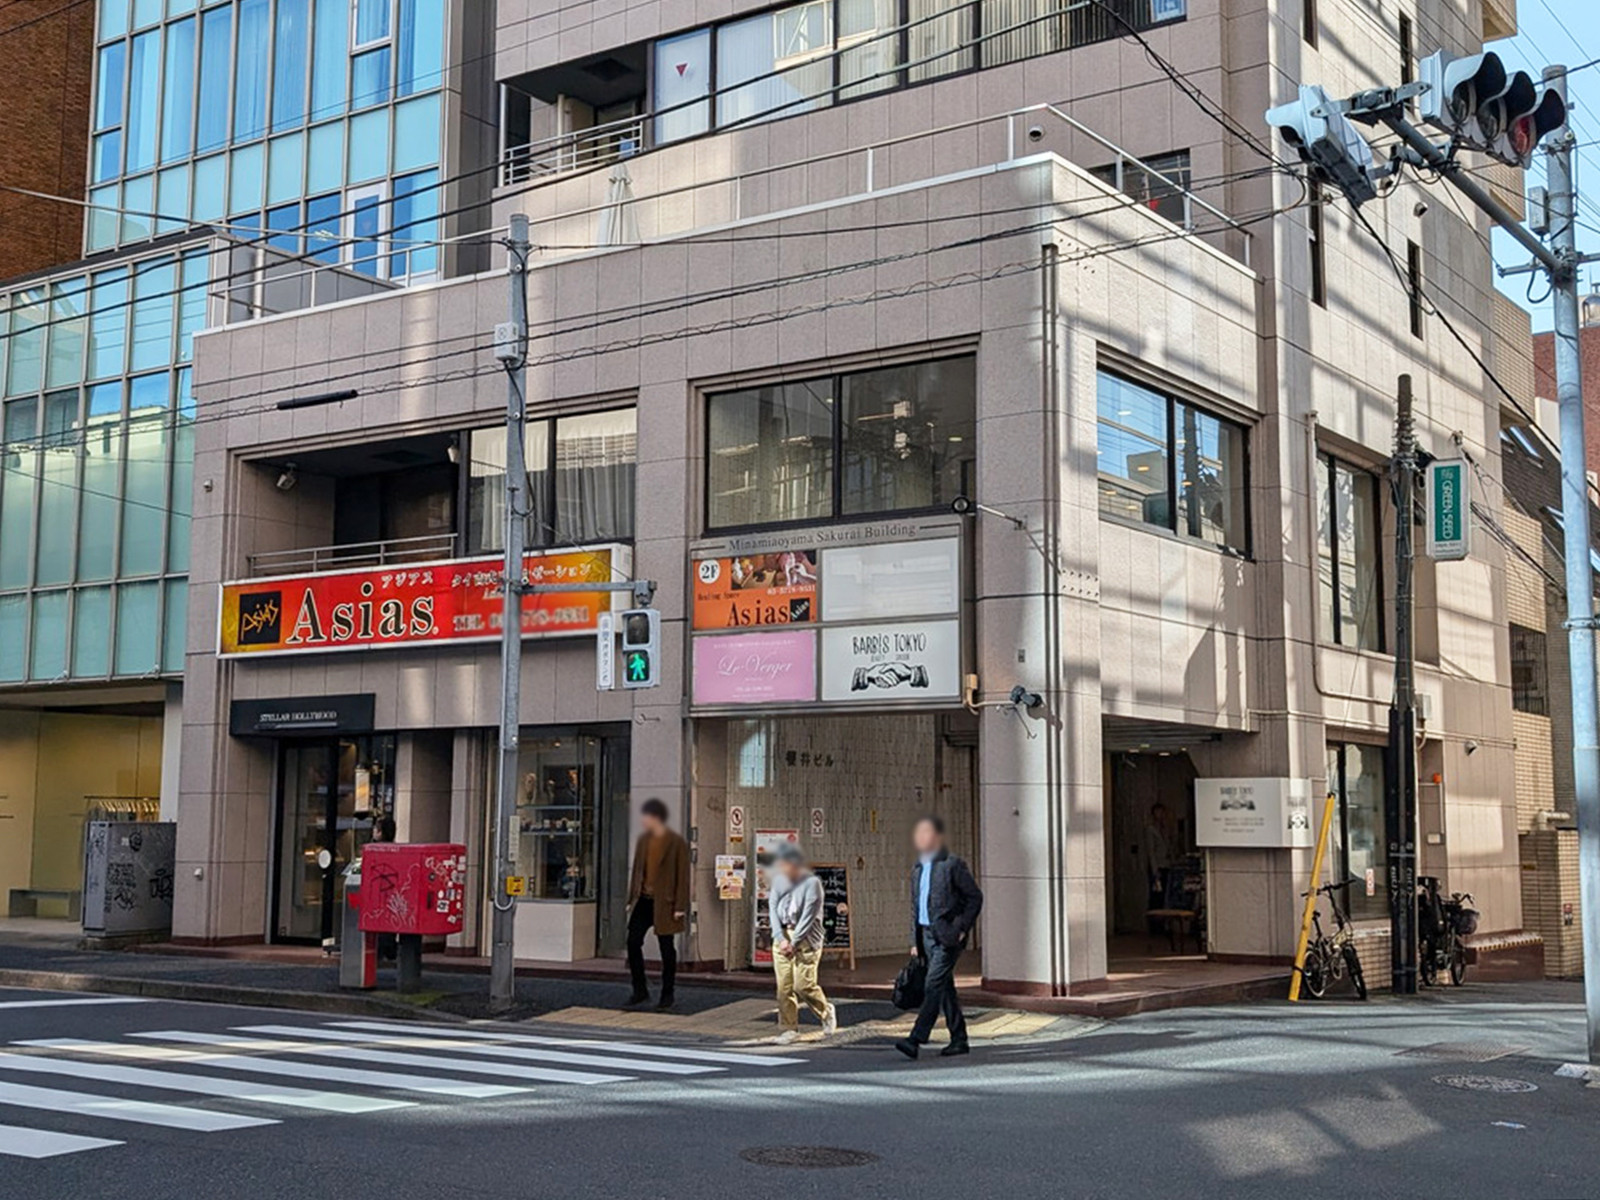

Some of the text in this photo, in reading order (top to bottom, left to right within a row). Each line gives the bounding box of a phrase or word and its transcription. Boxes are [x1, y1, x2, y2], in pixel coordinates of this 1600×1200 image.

[1442, 480, 1454, 513] GREEN
[729, 523, 916, 551] Minamiaoyama Sakurai Building
[1442, 514, 1454, 540] SEED
[701, 564, 718, 579] 2F
[285, 582, 434, 643] Asias
[727, 600, 788, 627] Asias
[894, 632, 926, 652] TOKYO
[260, 713, 290, 722] STELLAR
